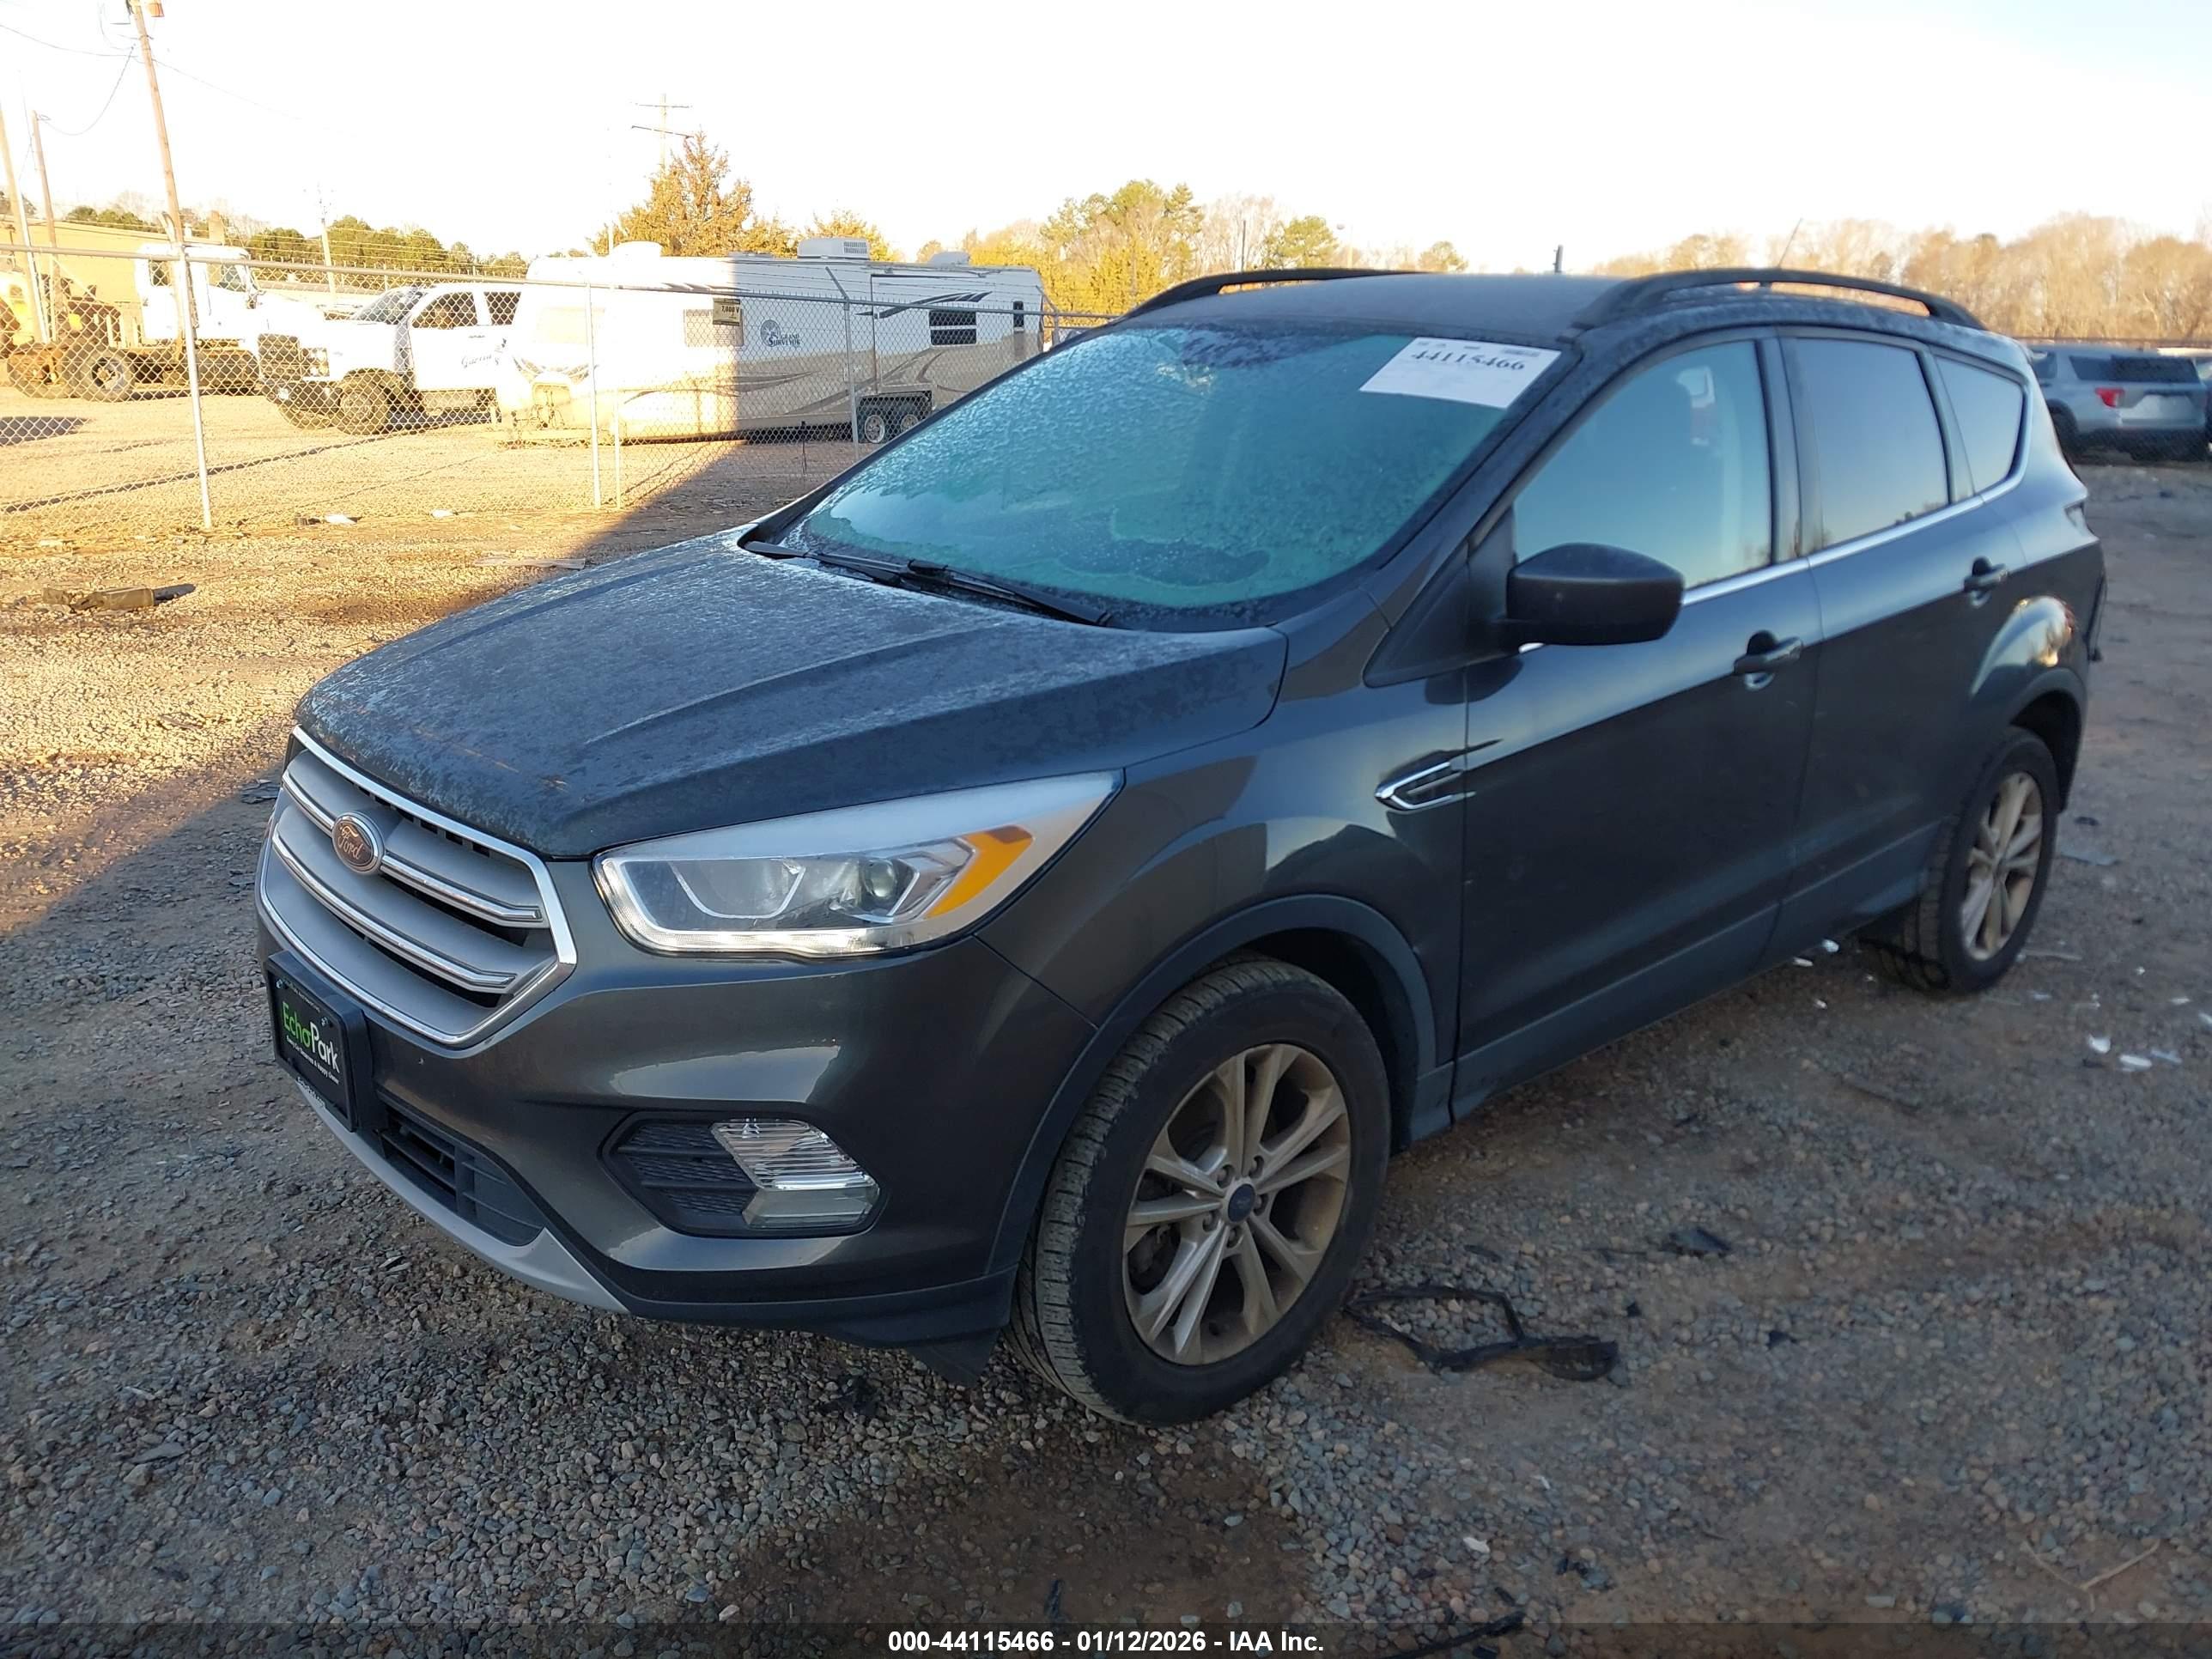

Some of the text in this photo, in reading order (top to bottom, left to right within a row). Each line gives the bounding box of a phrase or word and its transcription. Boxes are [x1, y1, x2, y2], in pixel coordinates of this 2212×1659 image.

[1411, 349, 1525, 370] 44115466
[337, 824, 363, 860] Ford
[283, 1000, 340, 1073] EchoPark
